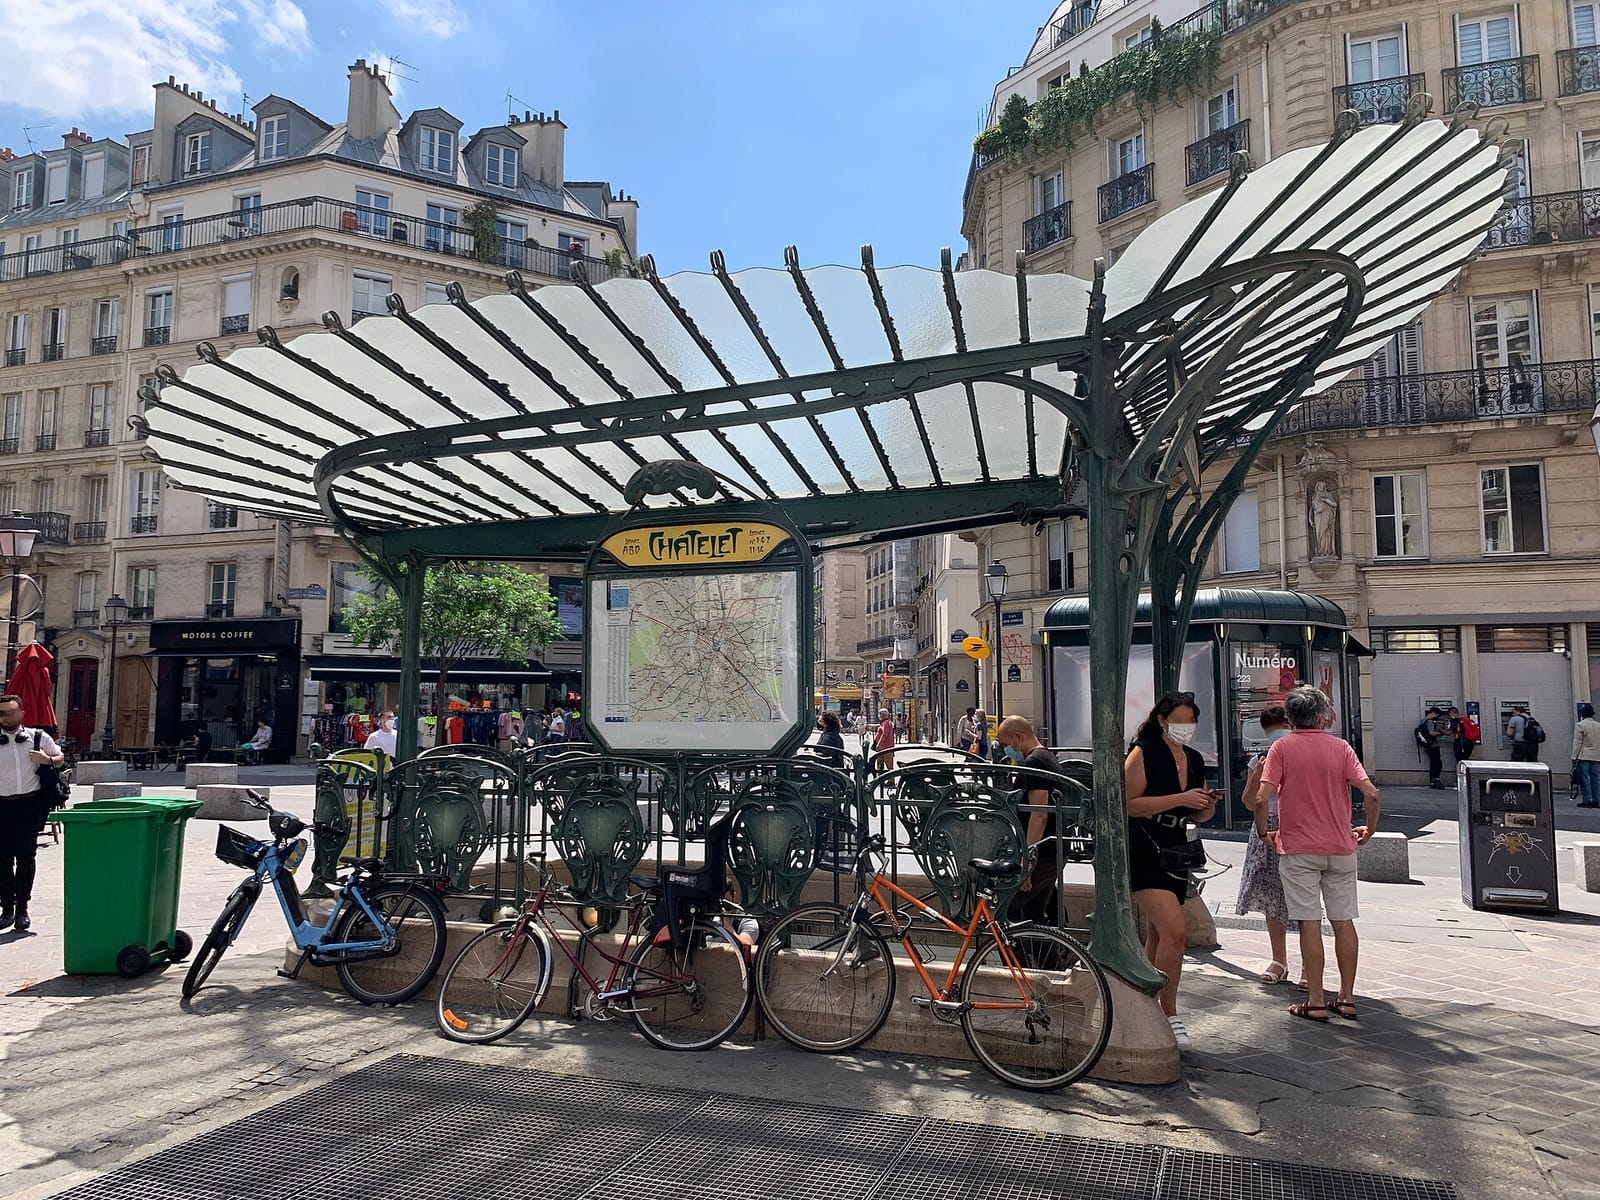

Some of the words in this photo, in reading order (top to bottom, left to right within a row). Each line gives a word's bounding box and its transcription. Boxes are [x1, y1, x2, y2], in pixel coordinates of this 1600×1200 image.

[649, 527, 743, 560] CHÂTELET
[220, 631, 253, 639] COFFEE
[1235, 652, 1296, 669] Numéro
[1237, 674, 1251, 683] 223
